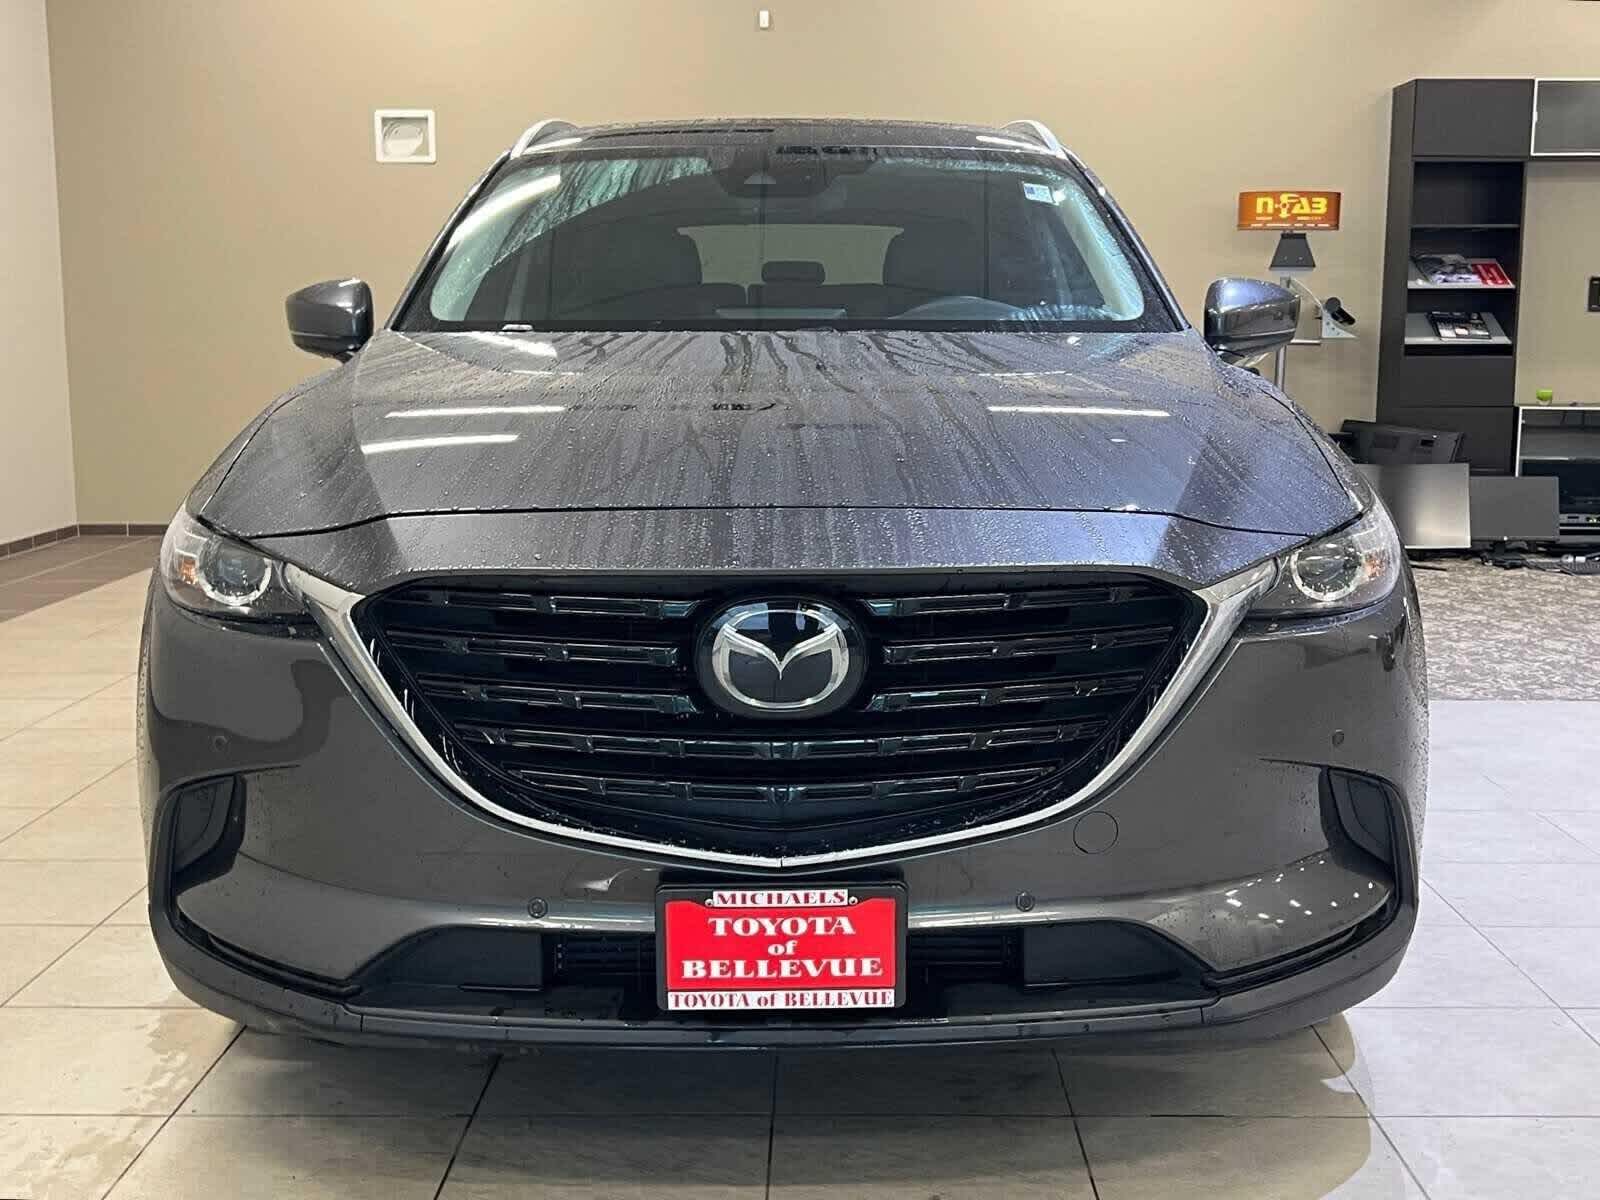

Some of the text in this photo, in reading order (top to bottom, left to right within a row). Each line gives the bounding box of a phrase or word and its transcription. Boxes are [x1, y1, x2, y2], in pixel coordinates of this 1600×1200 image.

[716, 891, 846, 906] MICHAELS
[708, 916, 856, 936] TOYOTA
[767, 940, 798, 956] of
[681, 957, 884, 979] BELLEVUE
[670, 990, 893, 1008] TOYOTA of BELLEVUE
